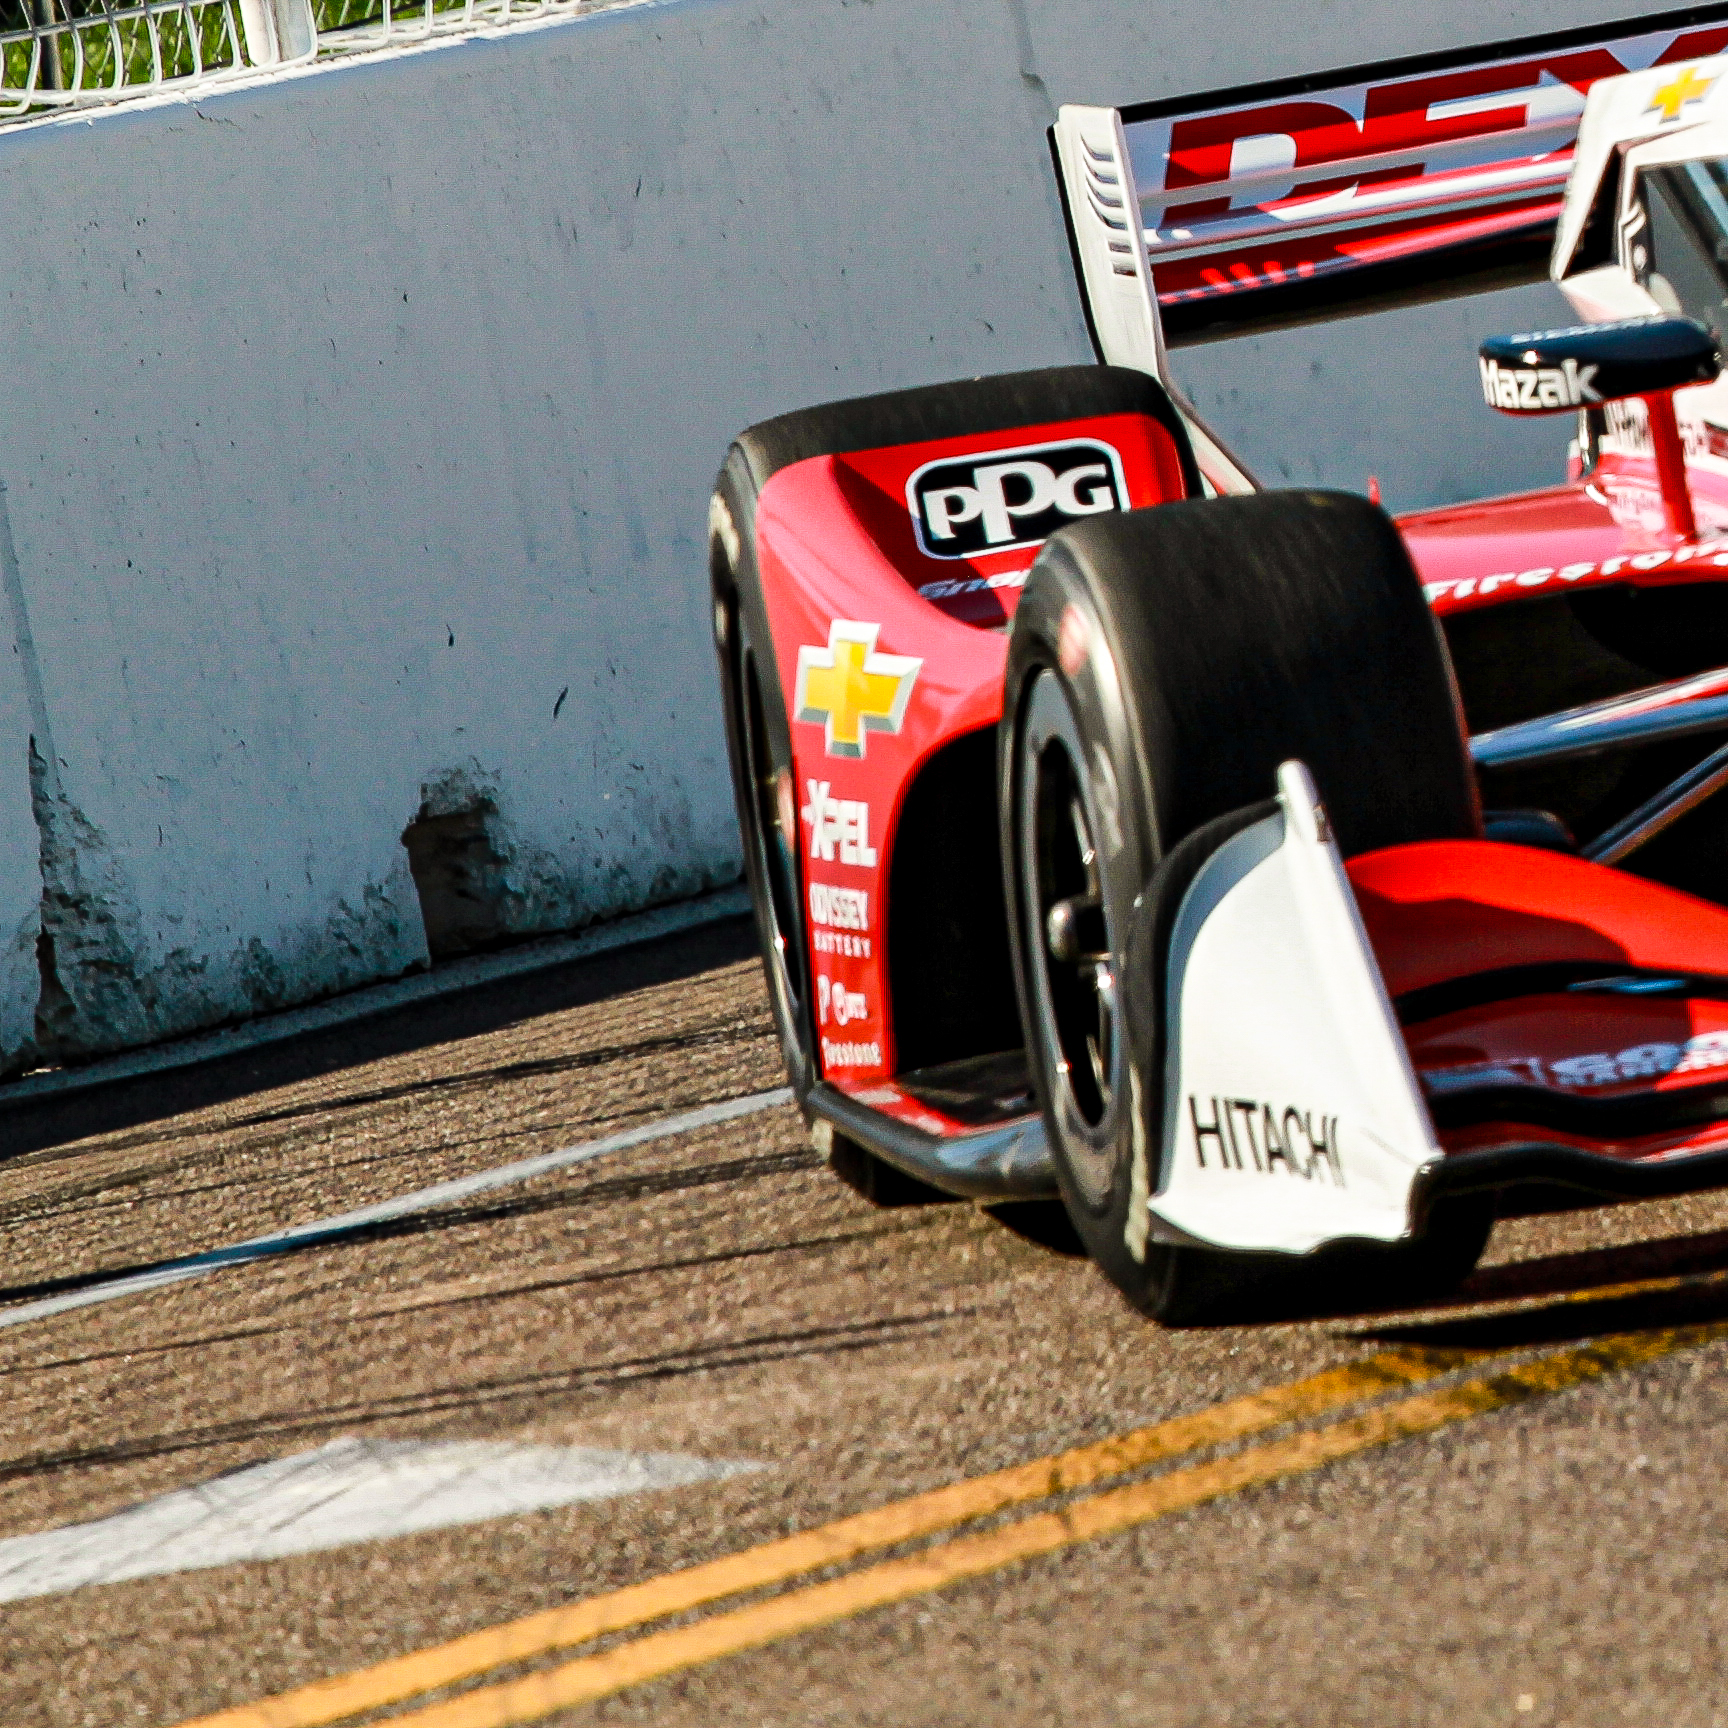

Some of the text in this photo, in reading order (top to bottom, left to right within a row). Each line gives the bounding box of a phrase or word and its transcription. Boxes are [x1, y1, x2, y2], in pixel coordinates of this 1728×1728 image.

[1479, 356, 1604, 409] Mazak
[922, 460, 1116, 544] PPG
[808, 779, 877, 867] XPEL
[1188, 1095, 1347, 1188] HITACHI
